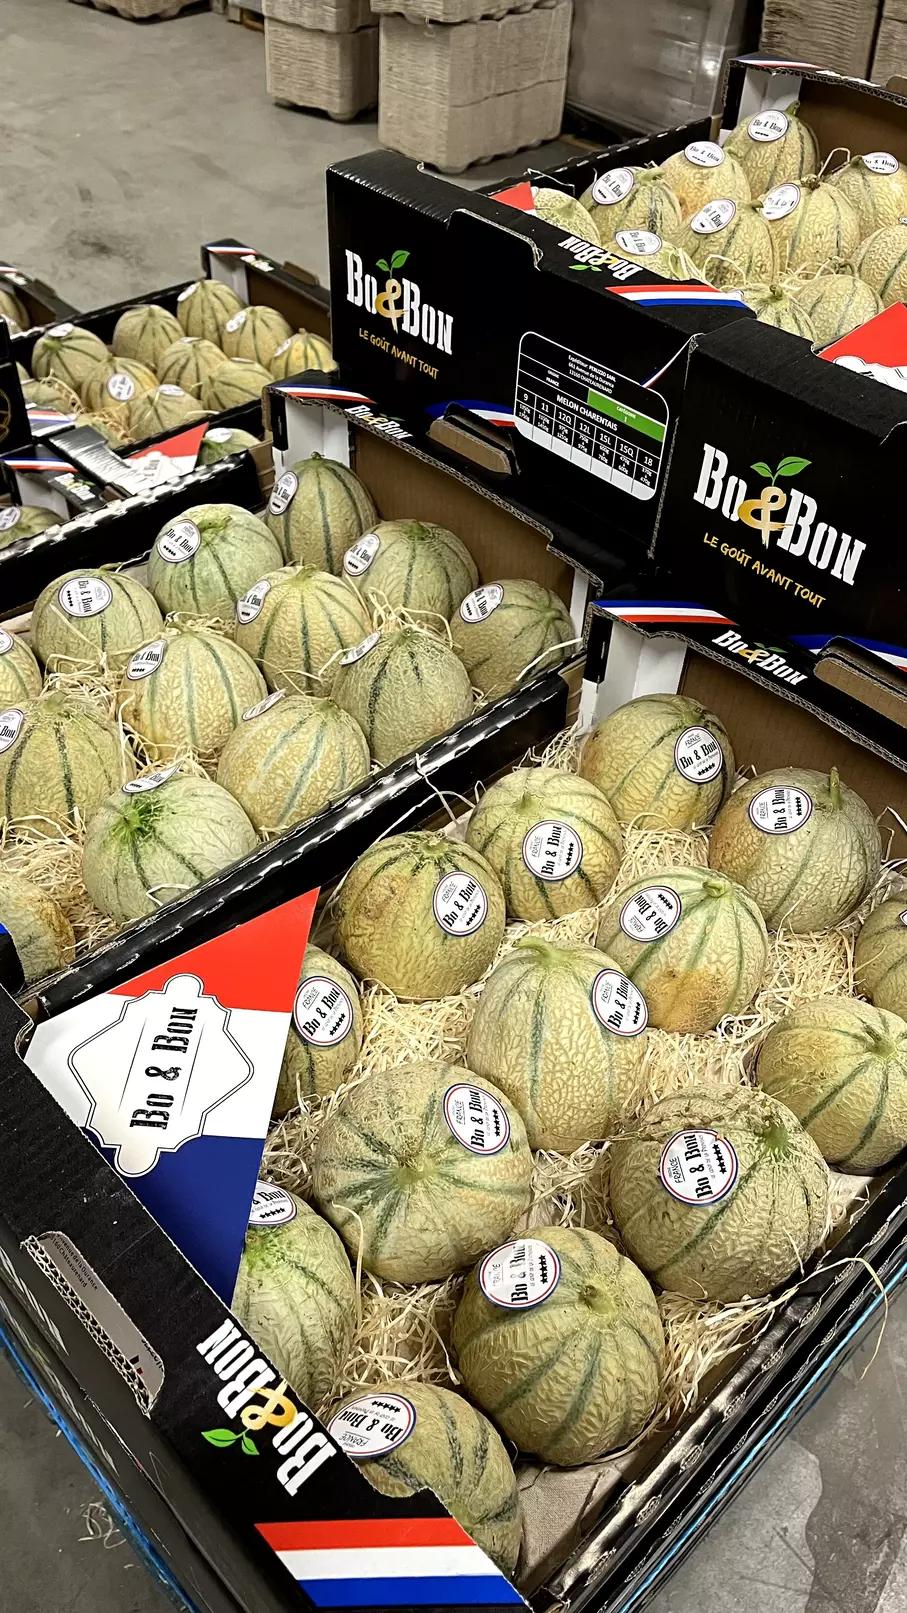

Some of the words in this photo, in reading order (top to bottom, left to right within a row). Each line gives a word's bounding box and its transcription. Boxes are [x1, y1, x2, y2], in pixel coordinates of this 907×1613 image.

[359, 328, 368, 340] LE
[370, 334, 390, 353] GOÛT
[391, 345, 417, 368] AVANT
[418, 359, 439, 379] TOUT
[524, 393, 528, 401] 9
[541, 403, 549, 413] 11
[557, 395, 579, 411] MELON
[580, 407, 618, 431] CHARENTAIS
[559, 412, 571, 425] 12Q
[580, 423, 590, 435] 12L
[600, 433, 611, 445] 15L
[620, 444, 634, 458] 15Q
[644, 456, 653, 466] 18
[703, 532, 718, 548] LE
[720, 543, 752, 567] GOÛT
[752, 560, 793, 590] AVANT
[794, 582, 826, 609] TOUT
[694, 749, 702, 760] &
[773, 806, 786, 814] &
[453, 901, 464, 911] &
[646, 911, 656, 921] &
[614, 999, 625, 1010] &
[315, 1007, 327, 1018] &
[145, 1065, 182, 1081] &
[470, 1116, 484, 1125] &
[669, 1158, 683, 1183] FRANCE
[689, 1163, 705, 1173] &
[82, 1267, 98, 1289] Durance
[366, 1418, 379, 1431] &
[339, 1433, 368, 1446] FRANCE
